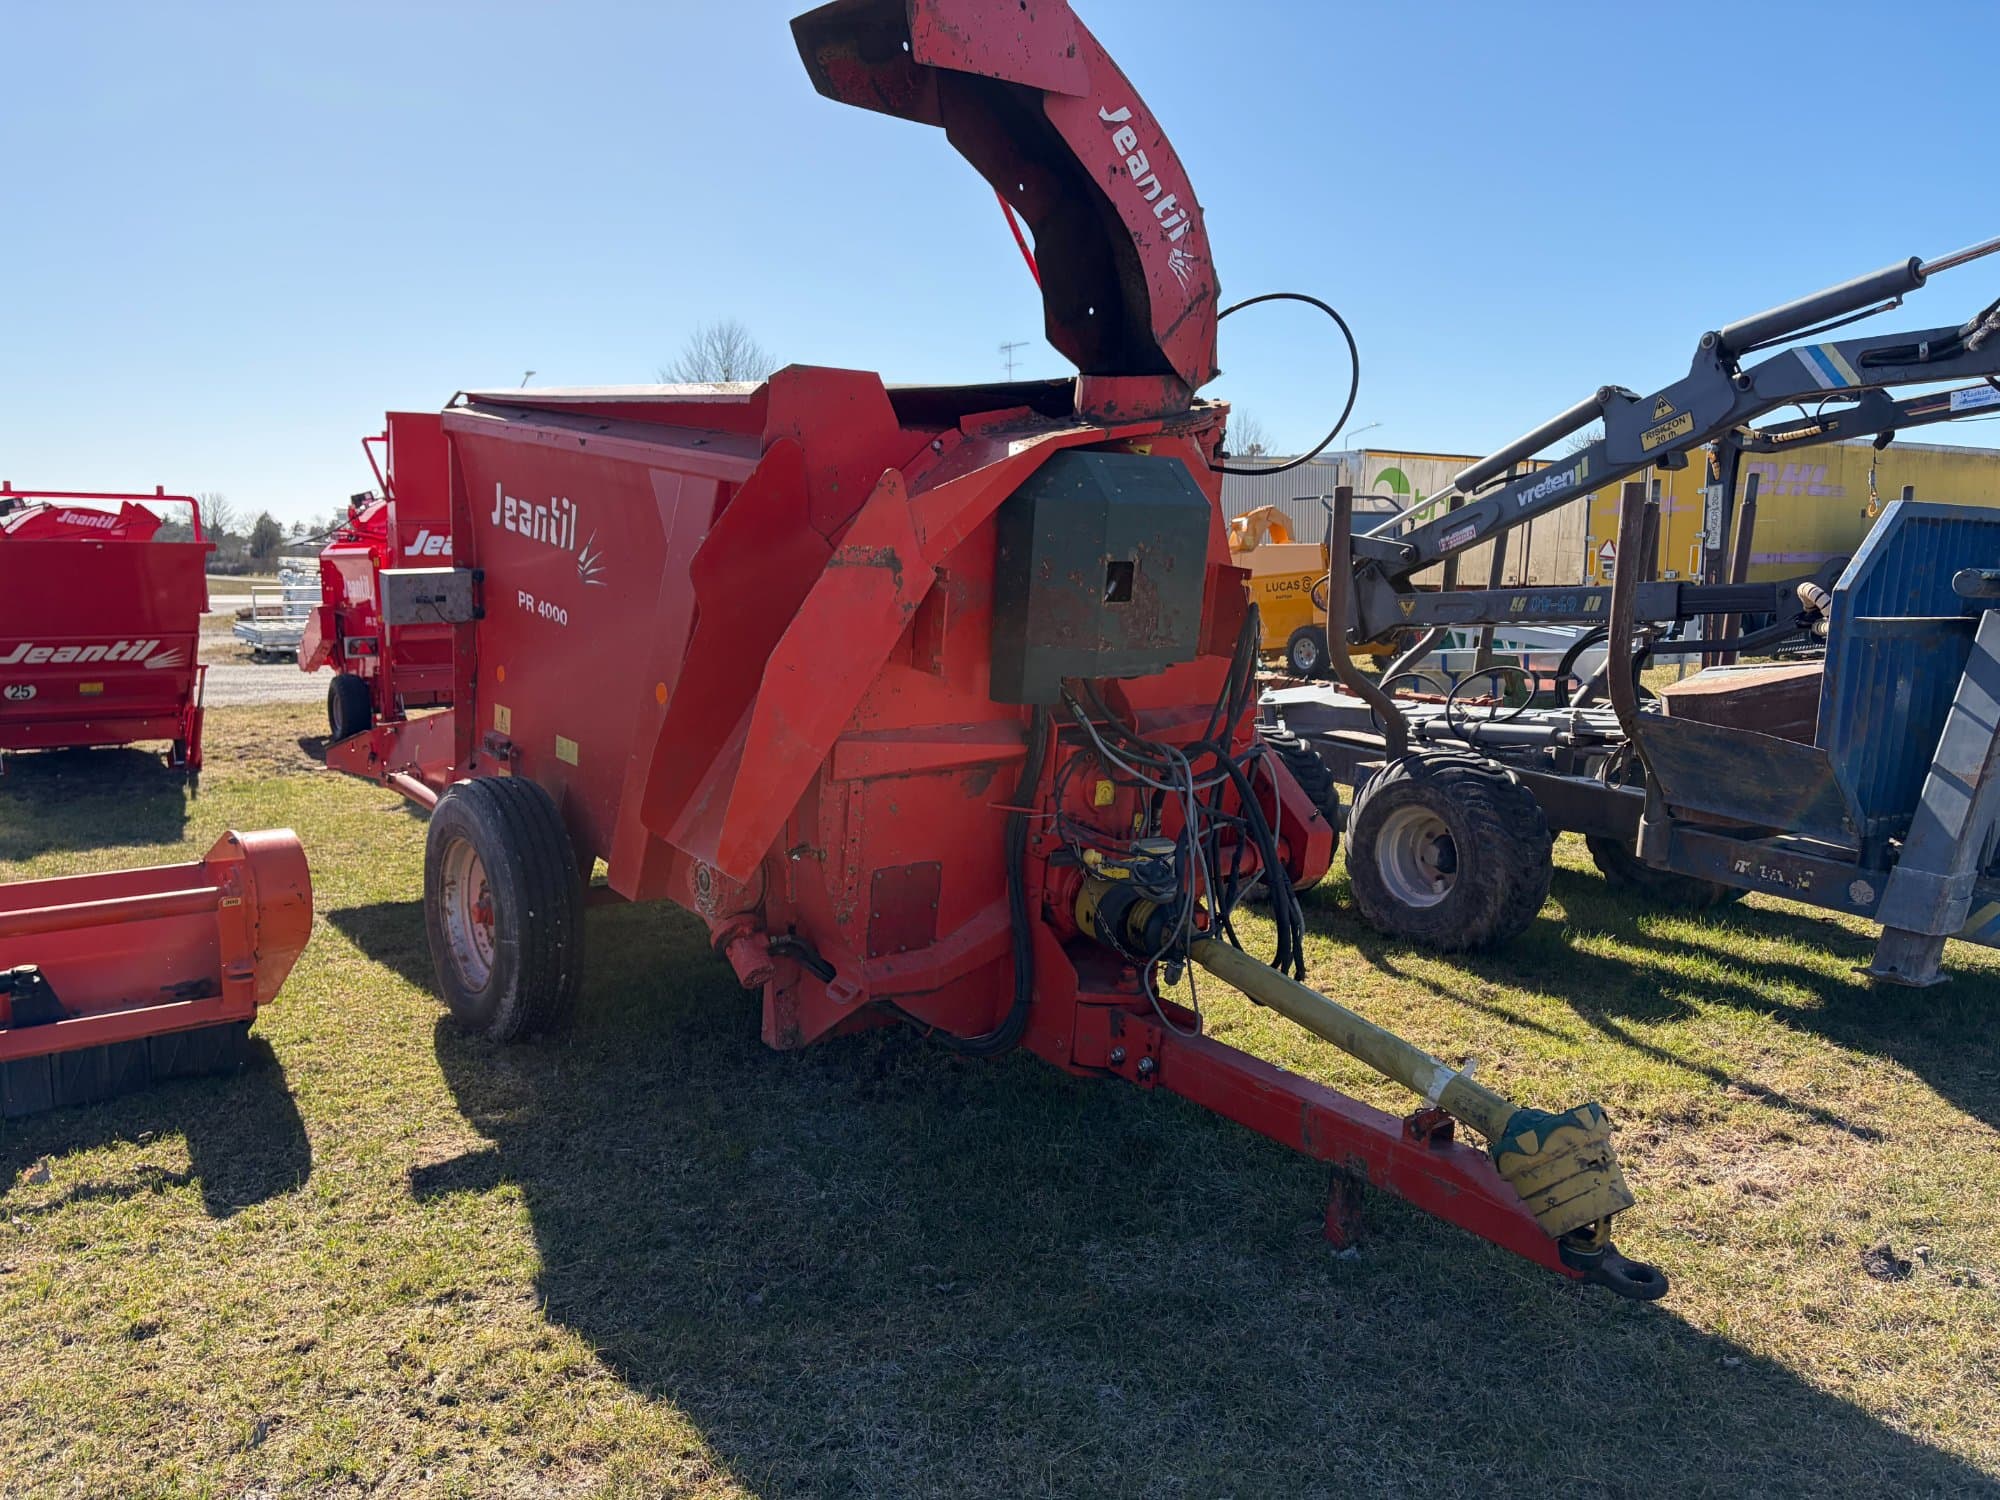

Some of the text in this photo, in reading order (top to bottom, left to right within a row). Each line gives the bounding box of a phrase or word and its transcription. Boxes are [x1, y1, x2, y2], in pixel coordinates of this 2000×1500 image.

[1098, 105, 1194, 243] Jeantil
[57, 510, 118, 529] Jeantil
[491, 482, 577, 550] Jeantil
[1265, 580, 1300, 592] LUCAS
[518, 590, 567, 625] PR 4000
[0, 639, 160, 664] Jeantil
[10, 685, 31, 699] 25
